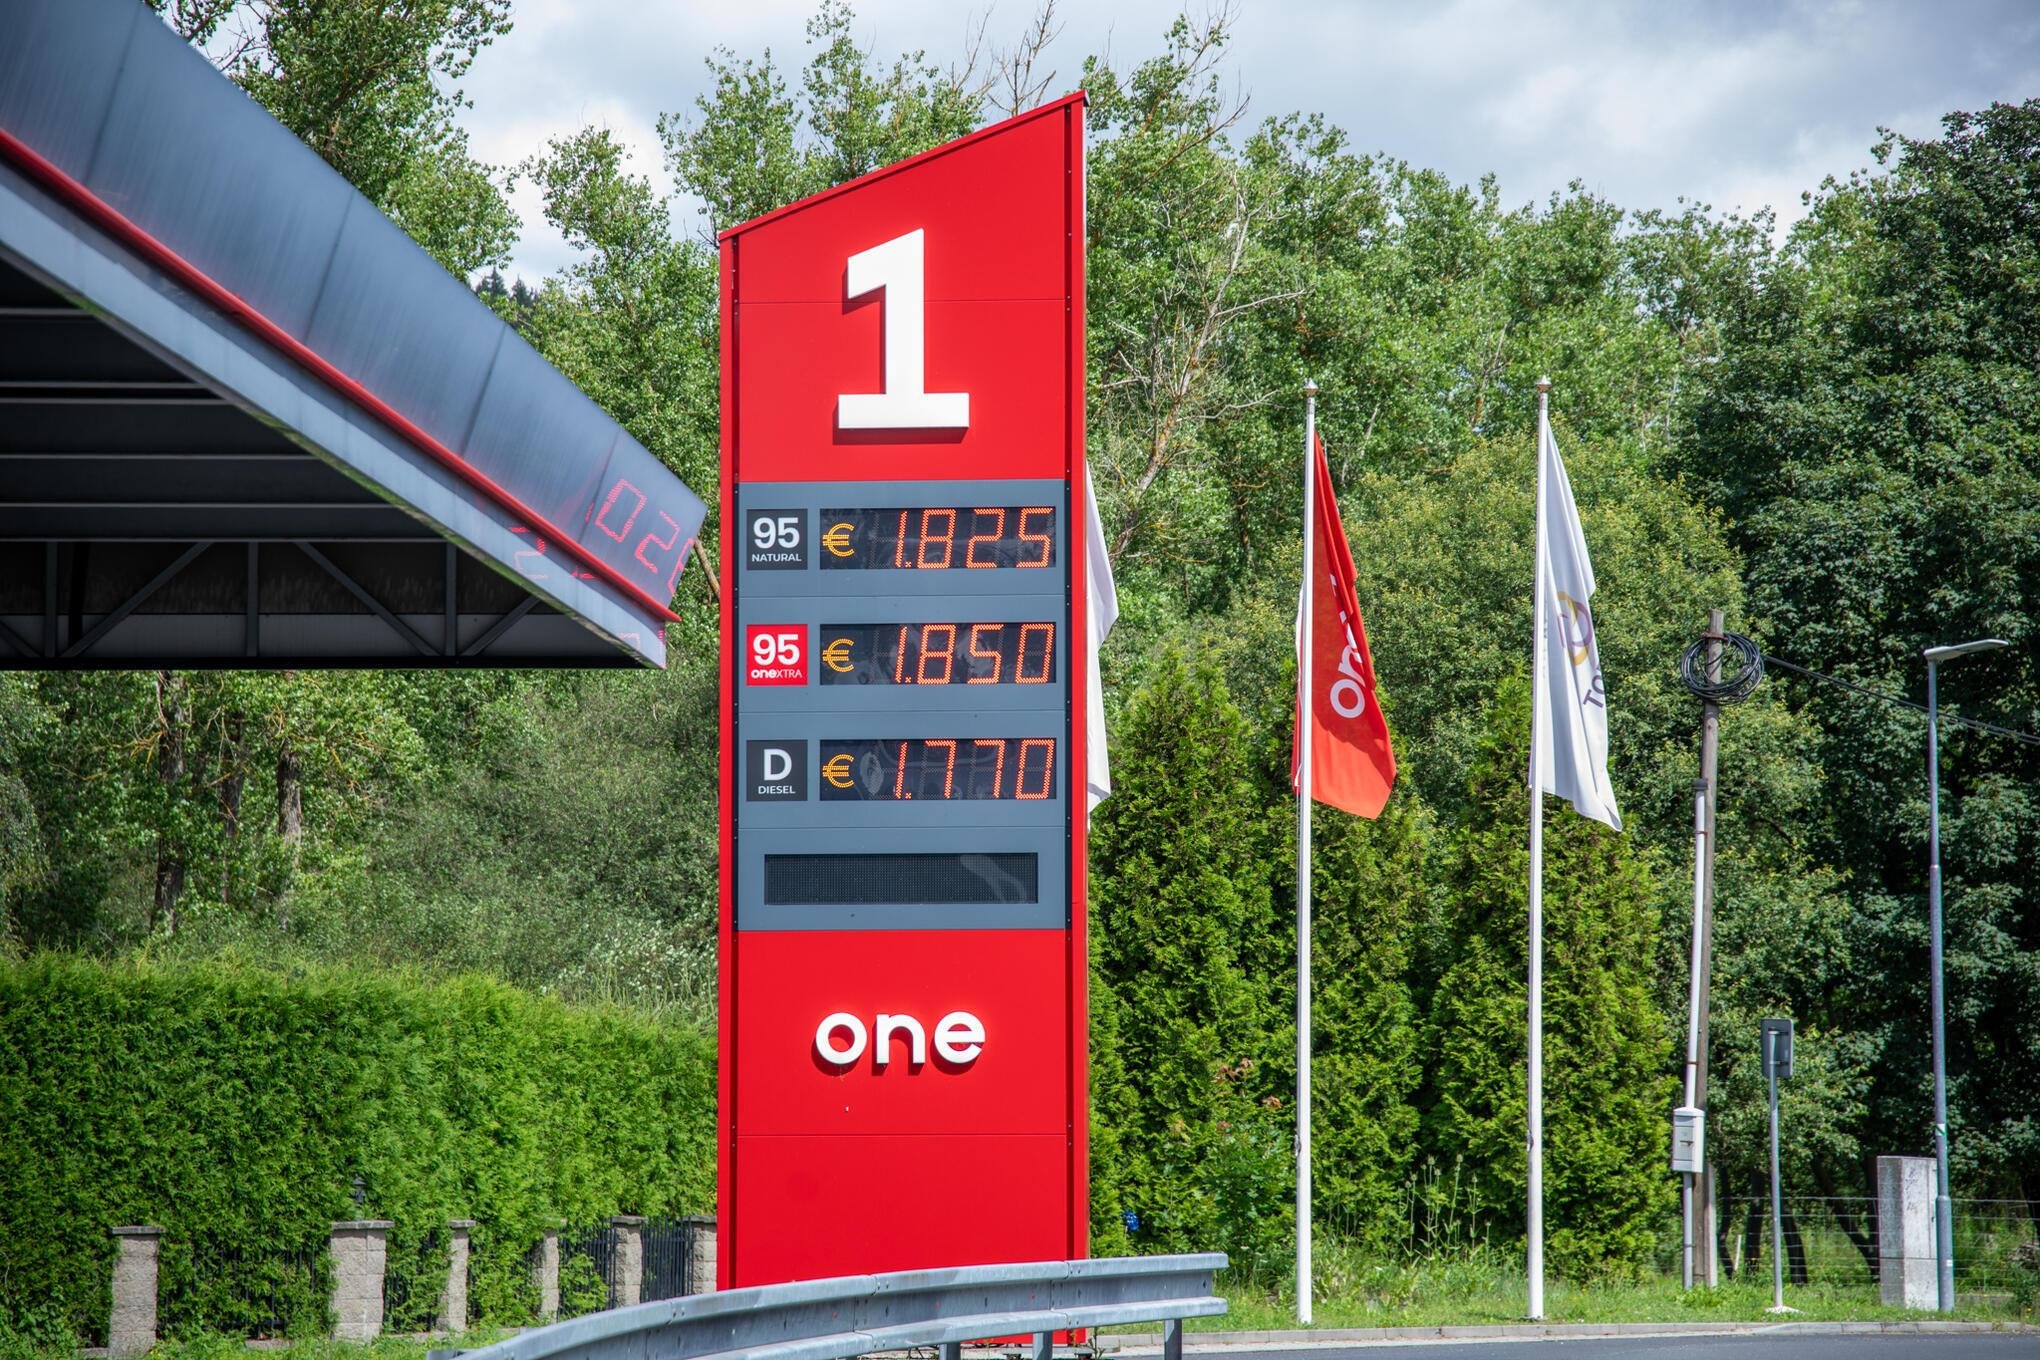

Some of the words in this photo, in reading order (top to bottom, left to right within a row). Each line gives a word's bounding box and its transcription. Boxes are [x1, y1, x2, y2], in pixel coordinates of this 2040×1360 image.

[838, 229, 970, 430] 1
[753, 517, 800, 549] 95
[822, 523, 855, 557] €
[894, 508, 1053, 569] 1.825
[751, 553, 802, 562] NATURAL
[753, 633, 800, 666] 95
[822, 638, 855, 673] €
[894, 623, 1054, 684] 1.850
[763, 748, 792, 781] D
[822, 753, 855, 789] €
[894, 739, 1054, 800] 1.770
[757, 785, 796, 795] DIESEL
[815, 1011, 986, 1065] one
